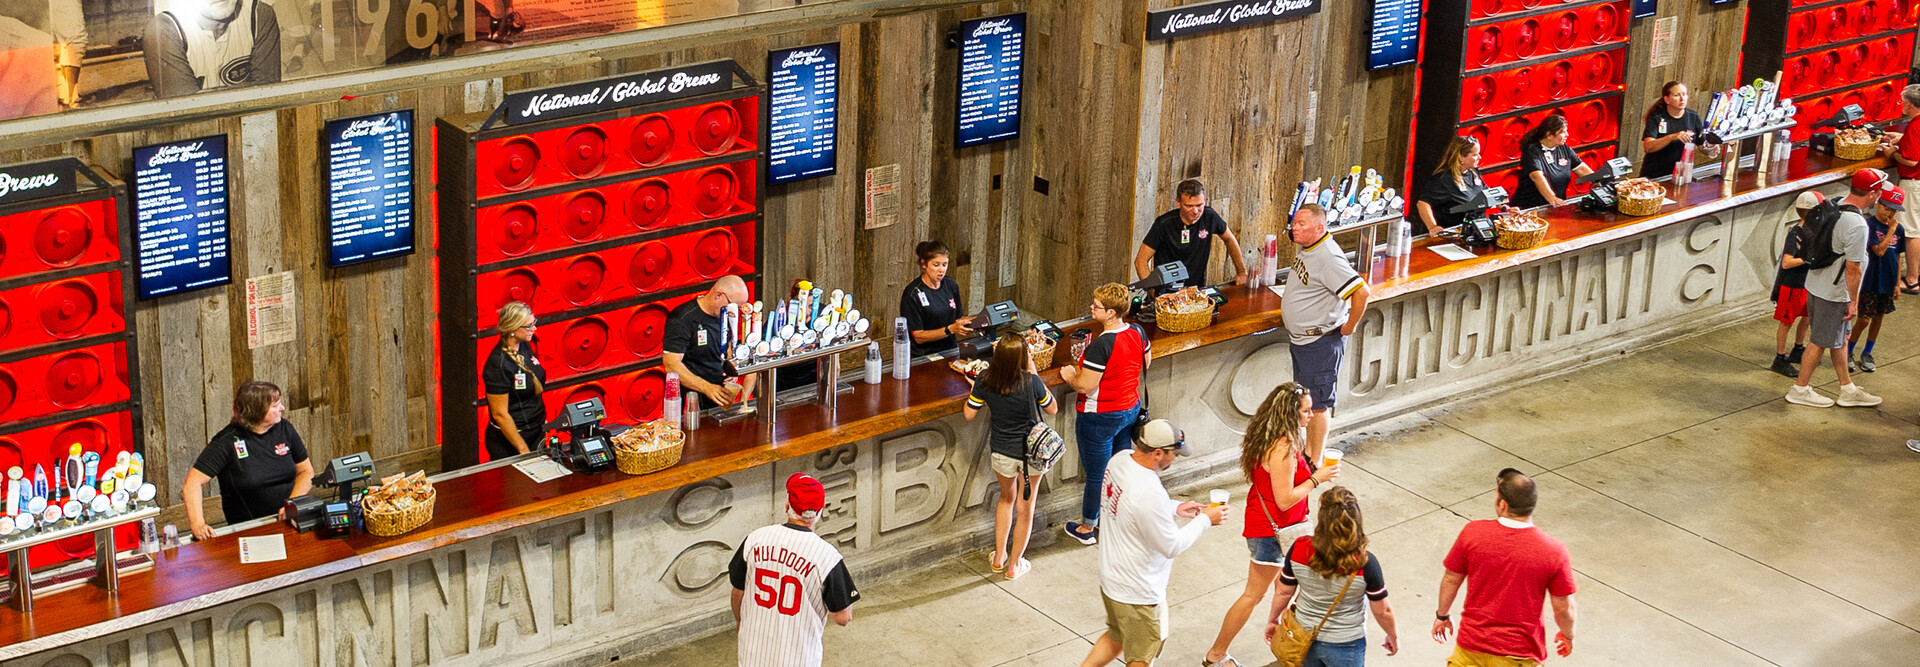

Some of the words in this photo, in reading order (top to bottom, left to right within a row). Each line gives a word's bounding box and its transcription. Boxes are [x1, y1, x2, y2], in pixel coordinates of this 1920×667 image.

[1161, 8, 1220, 34] National
[1230, 0, 1272, 23] Global
[1272, 0, 1313, 16] Brews
[521, 86, 600, 117] National
[612, 76, 667, 103] Global
[668, 72, 721, 93] Brews
[149, 154, 179, 167] Global
[248, 280, 256, 305] POLICY
[249, 306, 257, 336] ALCOHOL
[1350, 235, 1658, 397] CINCINNATI
[753, 545, 816, 578] MULDOON
[40, 510, 615, 667] CINNATI
[754, 567, 803, 616] 50
